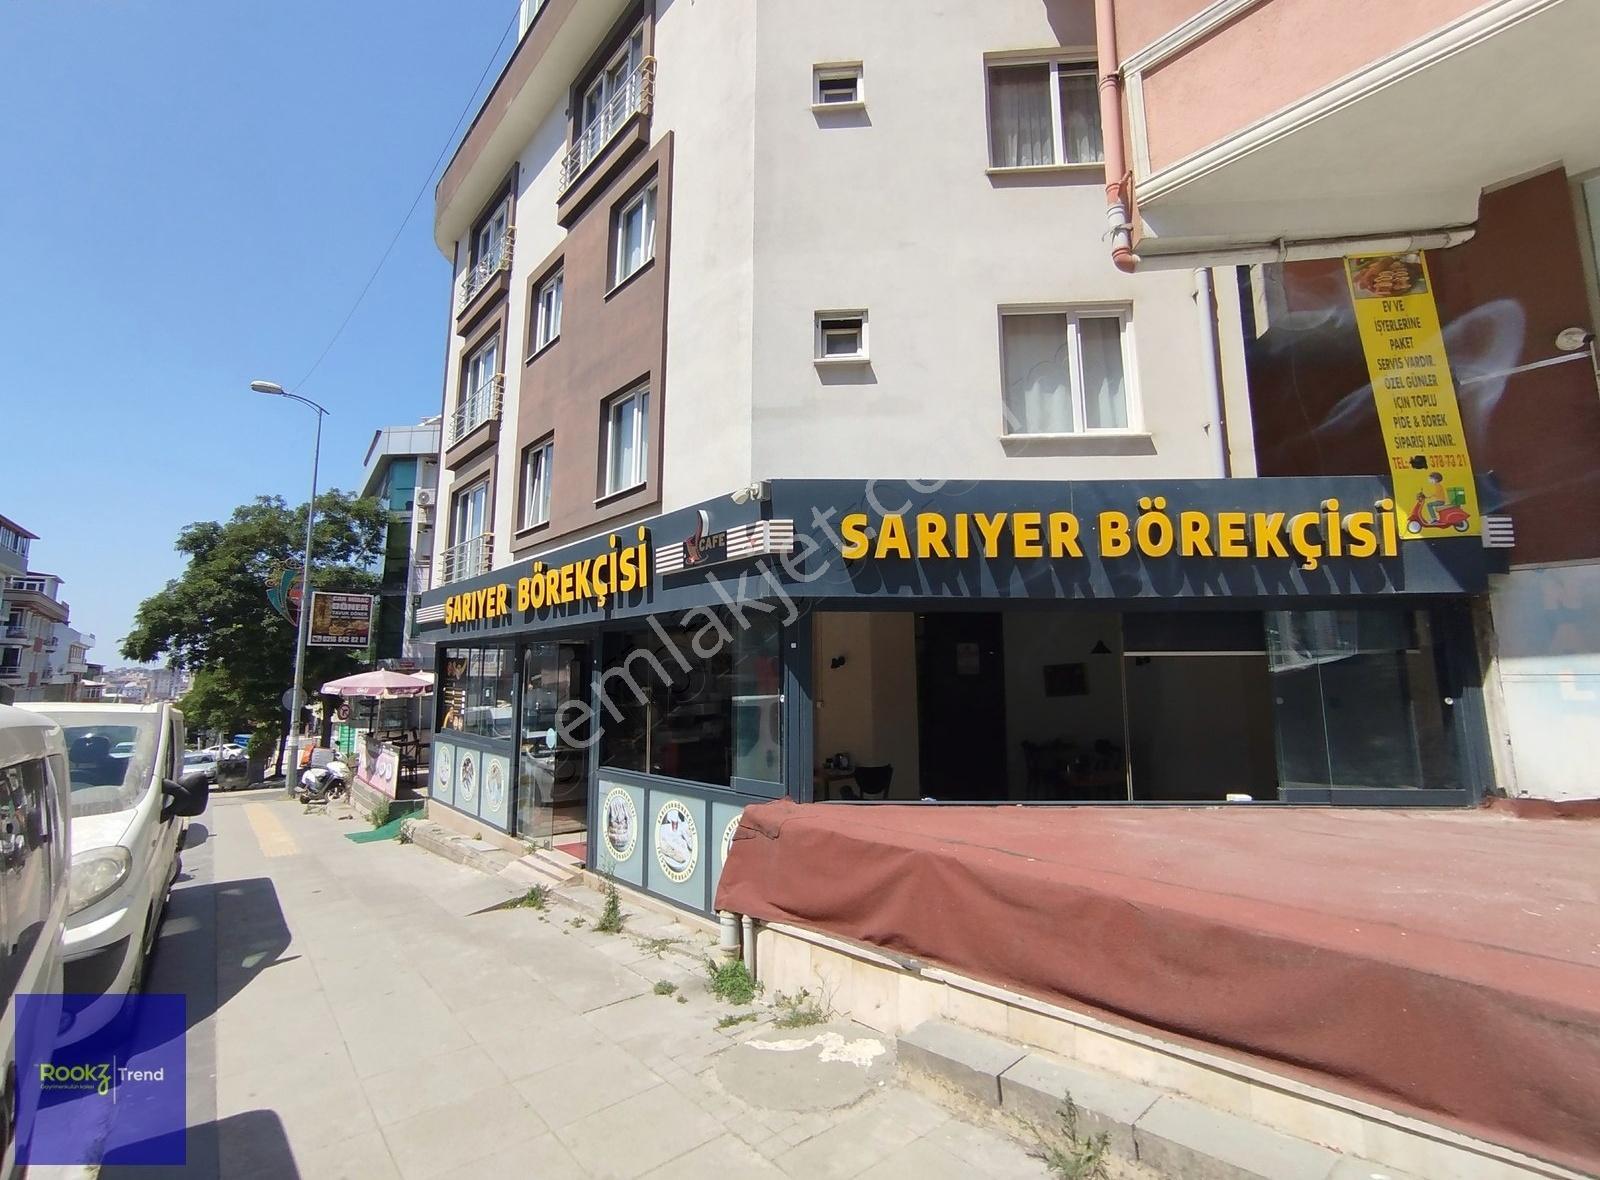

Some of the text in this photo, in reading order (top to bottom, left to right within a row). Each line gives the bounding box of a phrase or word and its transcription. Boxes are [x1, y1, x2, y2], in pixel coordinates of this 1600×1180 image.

[1382, 299, 1405, 312] EV VE
[1389, 337, 1414, 350] PAKET
[1377, 354, 1404, 371] SERVİS
[1406, 371, 1439, 388] GÜNLER
[1411, 394, 1438, 408] TOPLU
[1413, 416, 1420, 428] &
[1421, 411, 1448, 427] BÖREK
[841, 497, 1397, 570] SARIYER BÖREKÇİSİ
[700, 533, 726, 552] CAFE
[445, 525, 648, 624] SARIYER BÖREKÇİSİ
